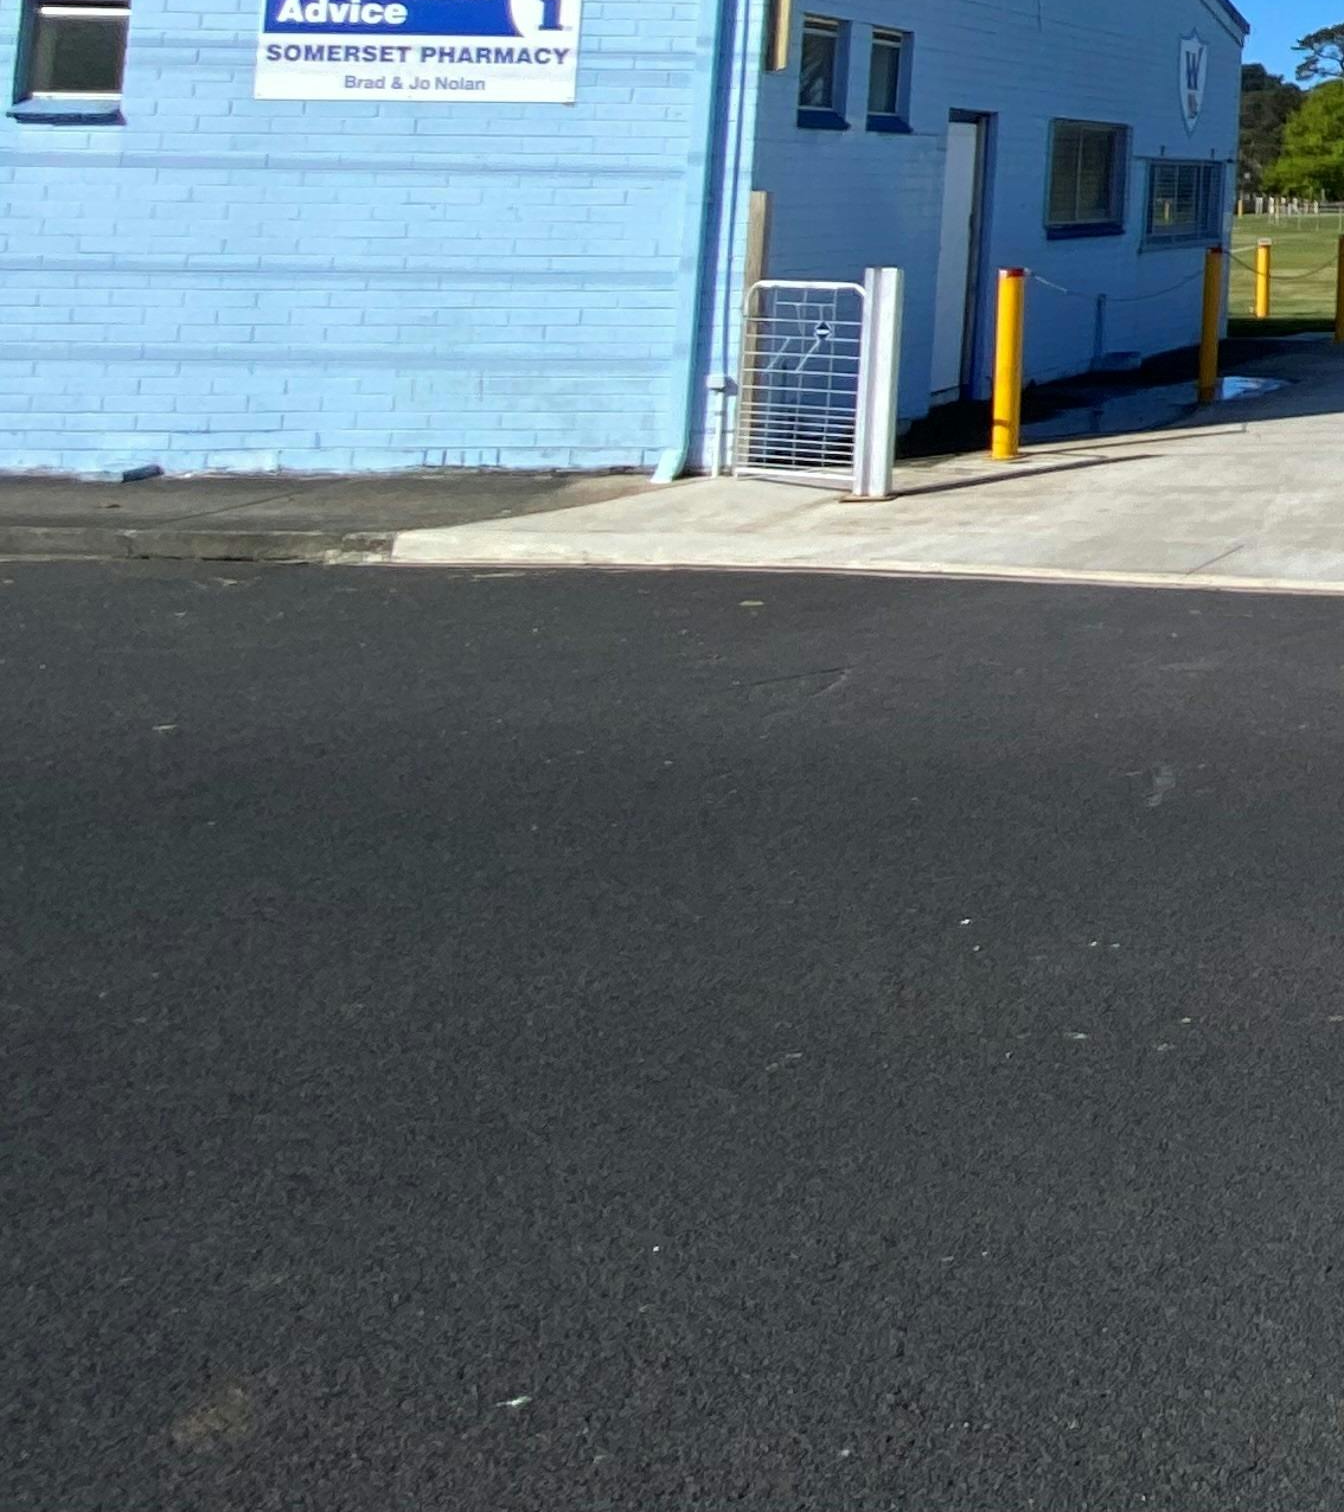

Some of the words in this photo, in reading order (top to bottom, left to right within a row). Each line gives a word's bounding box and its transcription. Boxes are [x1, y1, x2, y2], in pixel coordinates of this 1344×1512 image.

[265, 43, 412, 63] SOMERSET
[420, 46, 570, 65] PHARMACY
[343, 75, 386, 90] Brad
[390, 76, 404, 91] &
[408, 76, 432, 91] Jo
[435, 76, 486, 92] Nolan
